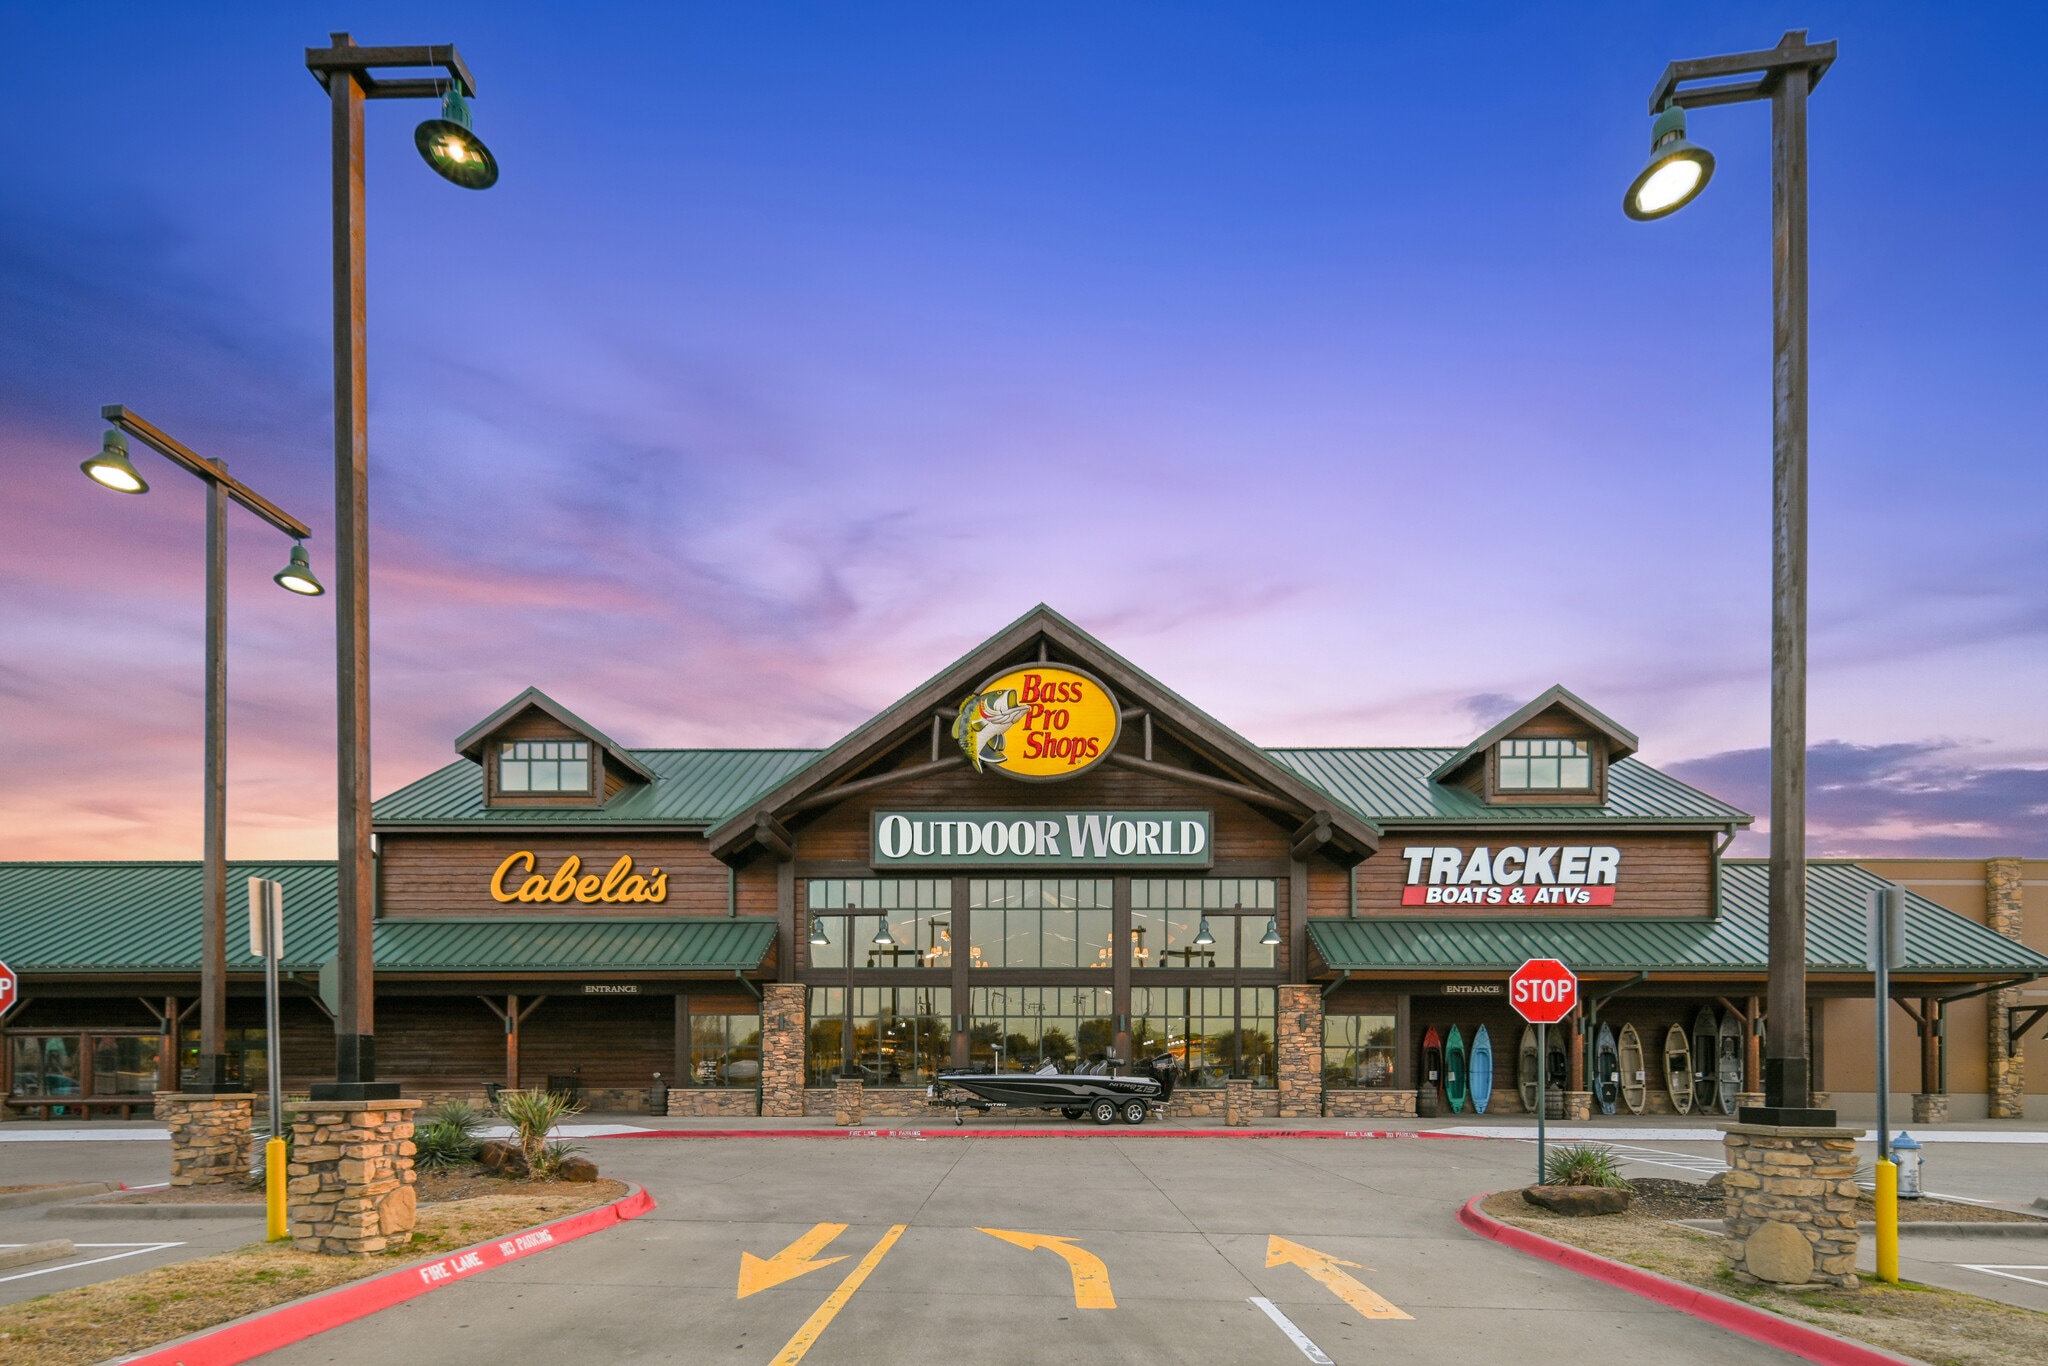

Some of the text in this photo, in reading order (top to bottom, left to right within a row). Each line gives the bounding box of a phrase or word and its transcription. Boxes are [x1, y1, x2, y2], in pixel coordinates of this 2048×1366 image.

[1019, 674, 1083, 703] Bass
[1022, 703, 1070, 731] Pro
[1023, 731, 1099, 765] Shops
[878, 814, 1206, 858] OUTDOOR WORLD
[490, 850, 668, 903] Cabela's
[1402, 846, 1621, 885] TRACKER
[1425, 887, 1590, 904] BOATS & ATVs
[585, 985, 637, 993] ENTRANCE
[1446, 985, 1500, 993] ENTRANCE
[1514, 979, 1572, 1003] STOP
[1108, 1082, 1157, 1094] NITRO Z19
[419, 1229, 553, 1284] FIRE LANE NO PARKING
